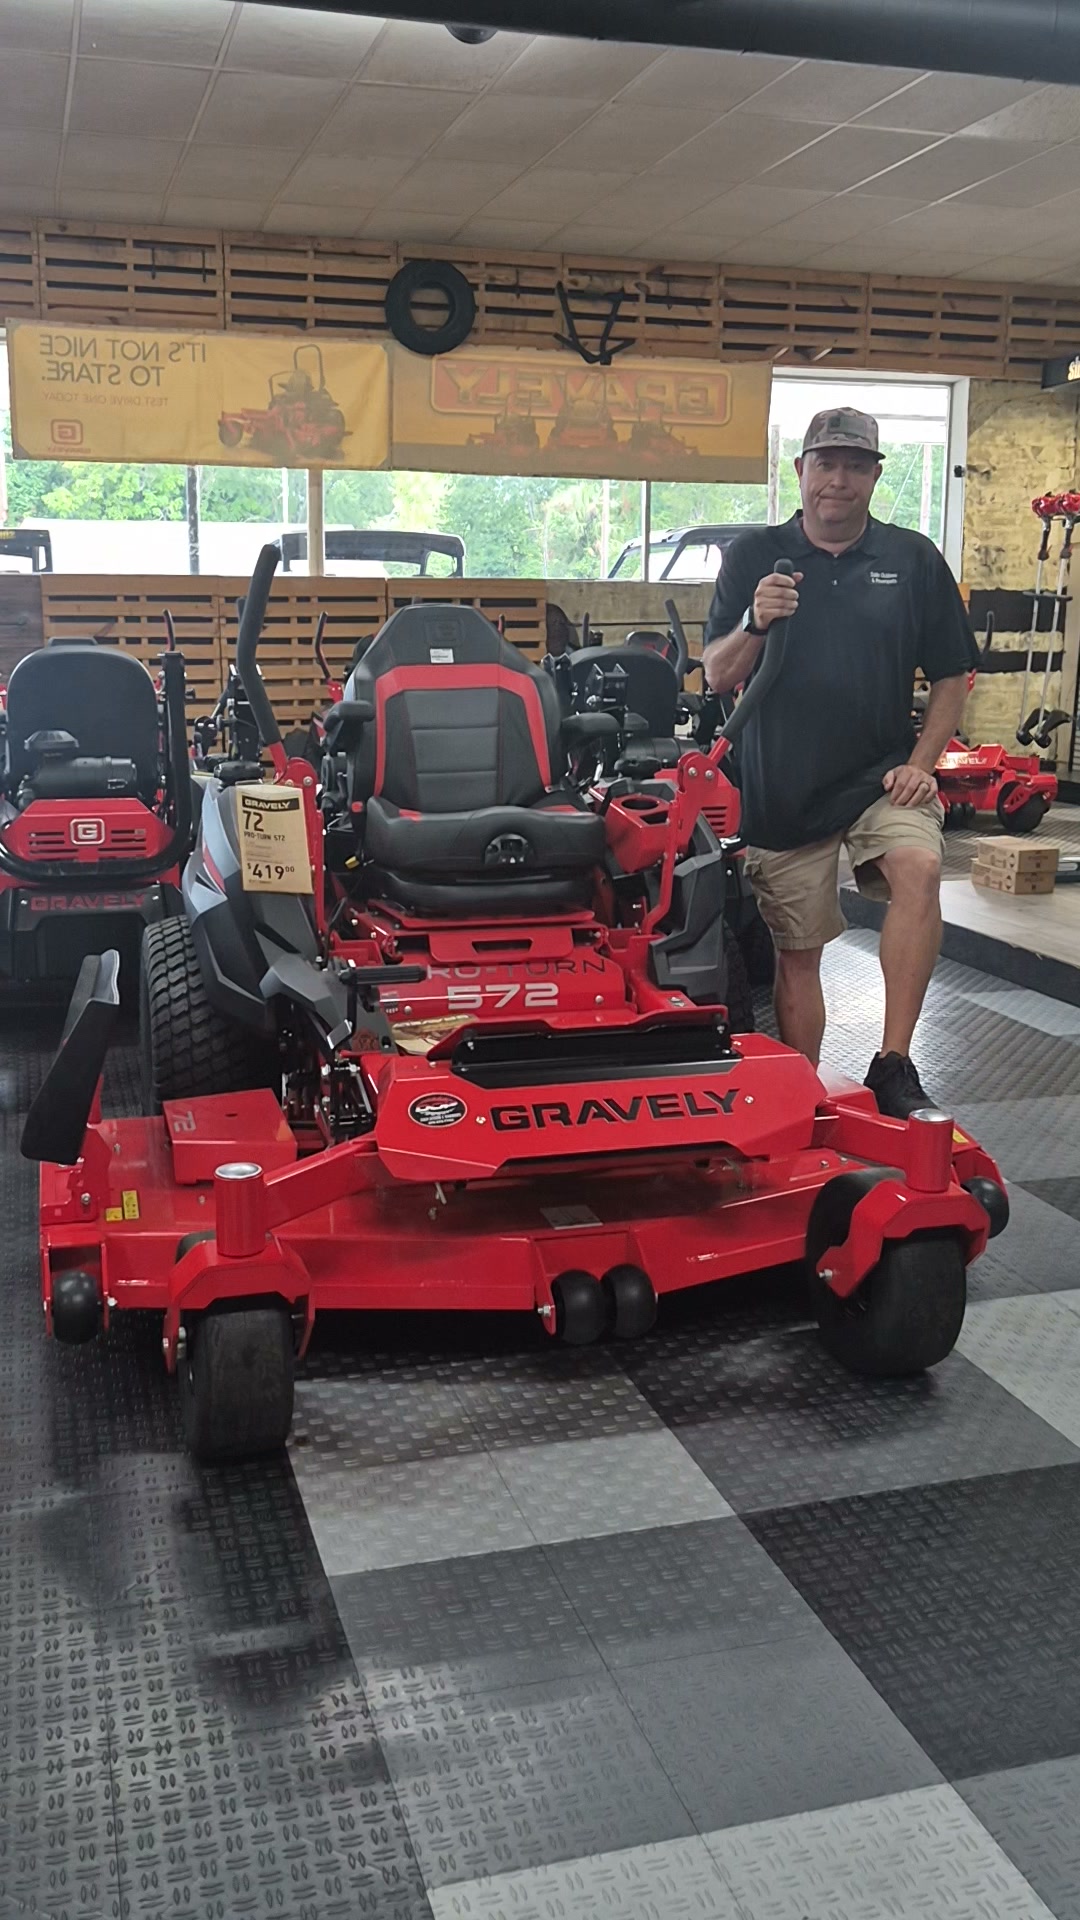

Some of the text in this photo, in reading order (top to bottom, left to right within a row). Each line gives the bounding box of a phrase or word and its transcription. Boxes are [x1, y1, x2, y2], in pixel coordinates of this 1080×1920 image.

[245, 798, 290, 810] GRAVELY
[77, 824, 98, 840] G
[243, 811, 264, 832] 72
[30, 893, 146, 911] GRAVELY
[426, 959, 606, 980] RO-TURN
[447, 982, 559, 1010] 572
[490, 1088, 741, 1131] GRAVELY
